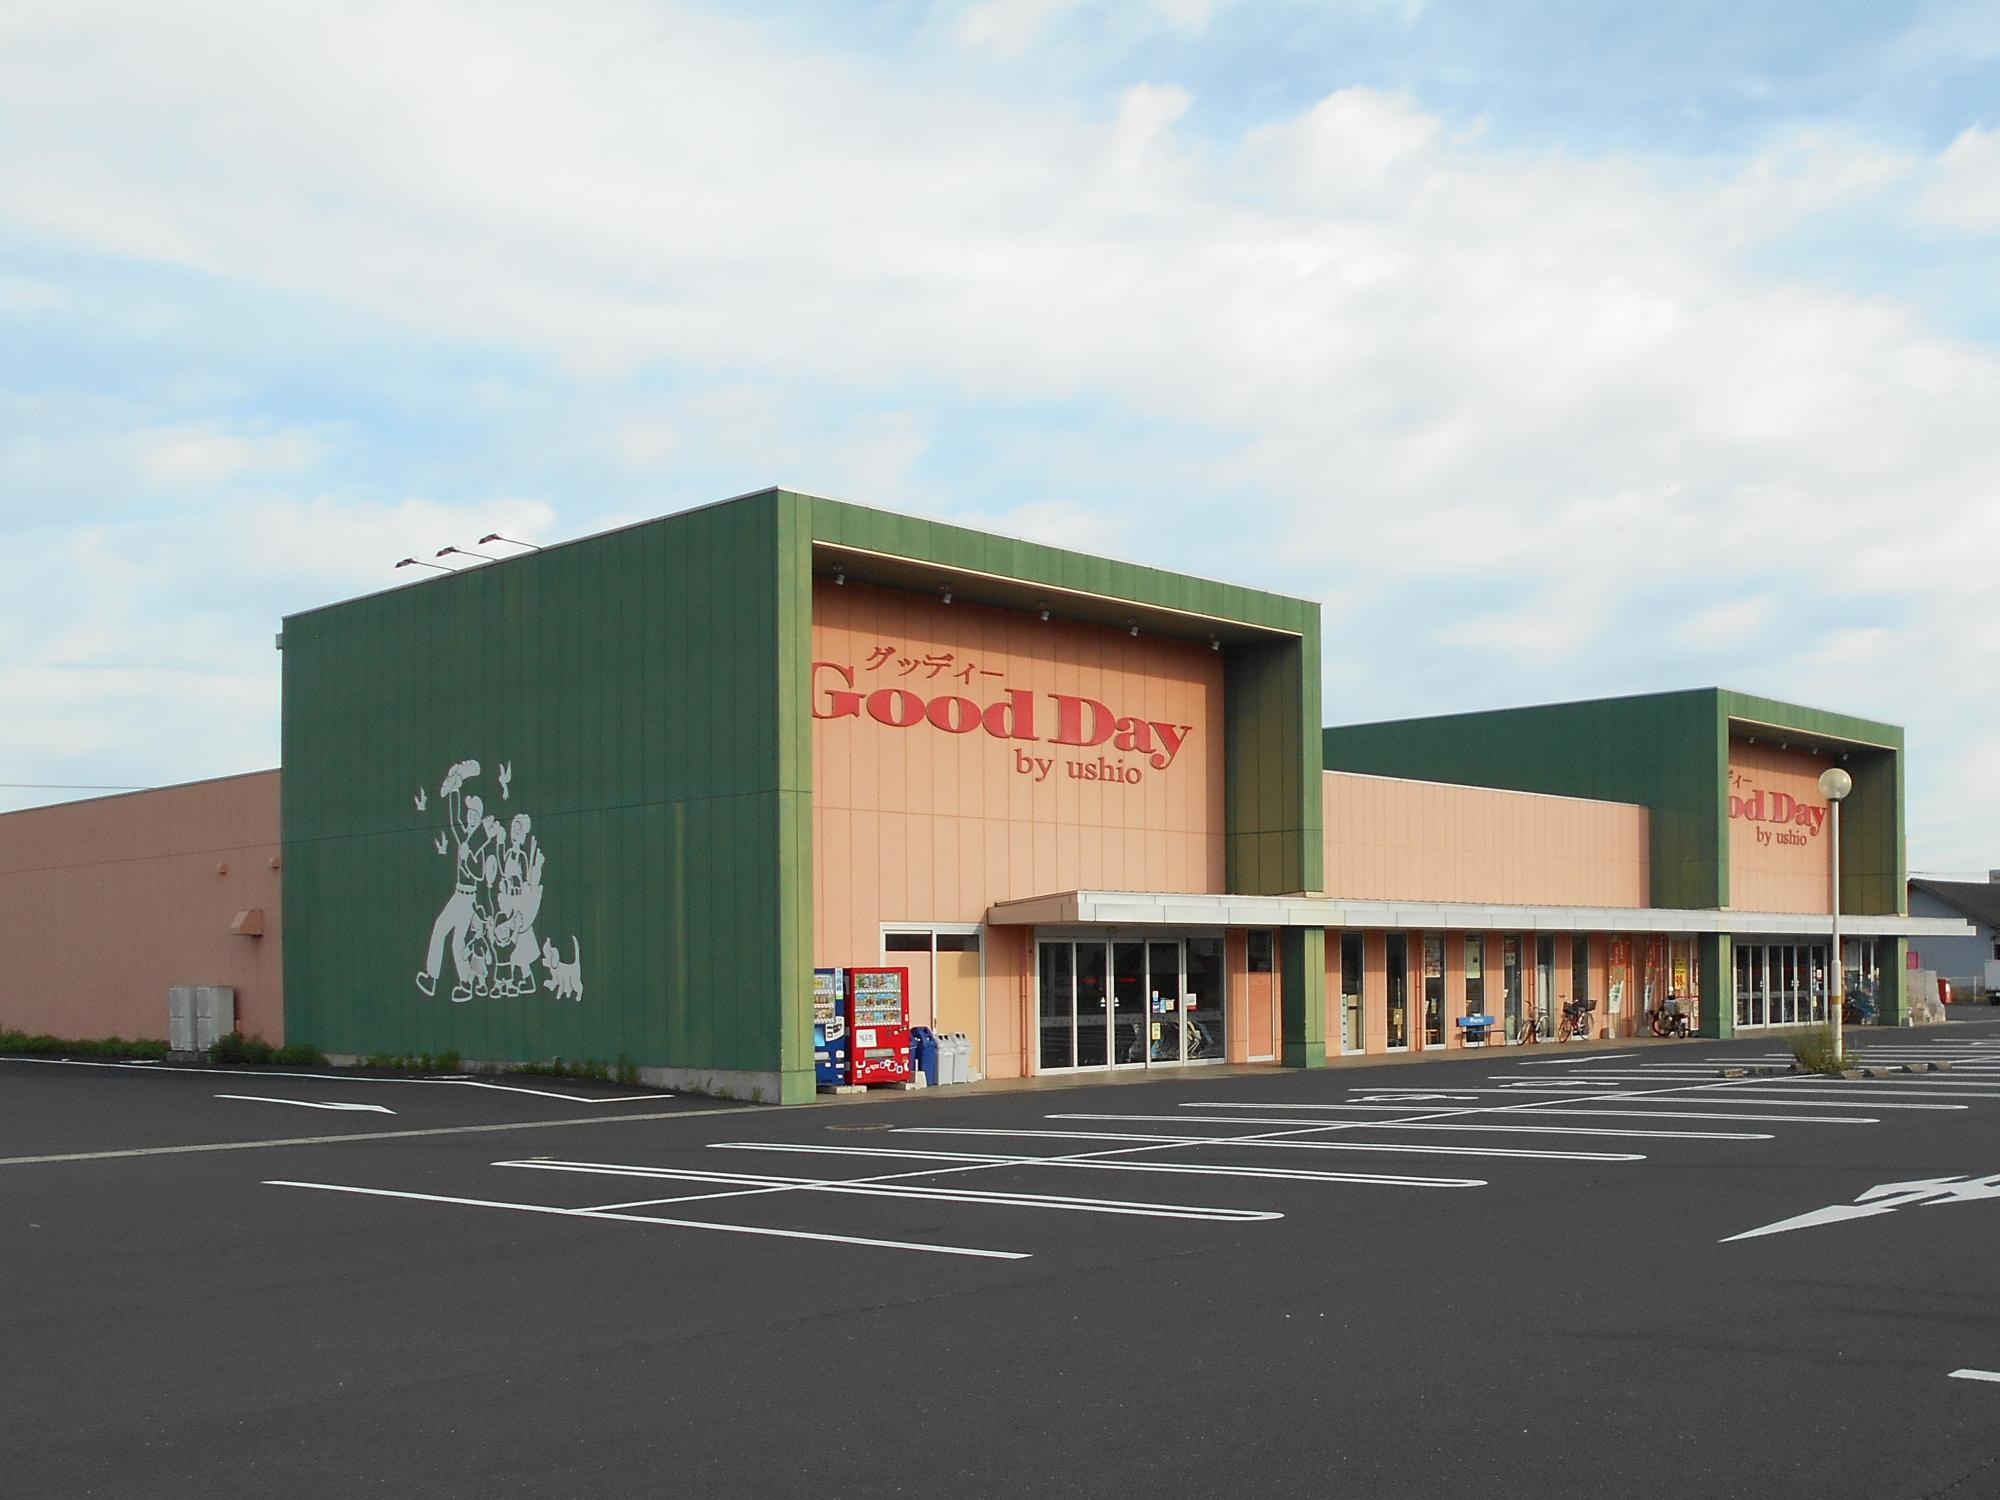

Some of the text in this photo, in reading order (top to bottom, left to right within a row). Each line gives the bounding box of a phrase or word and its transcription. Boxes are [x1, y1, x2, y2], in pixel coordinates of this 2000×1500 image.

[865, 646, 1004, 685] グッディー
[812, 661, 1193, 770] Good Day
[1014, 748, 1143, 785] by ushio
[1729, 789, 1827, 836] od Day
[1756, 826, 1808, 847] by ushio
